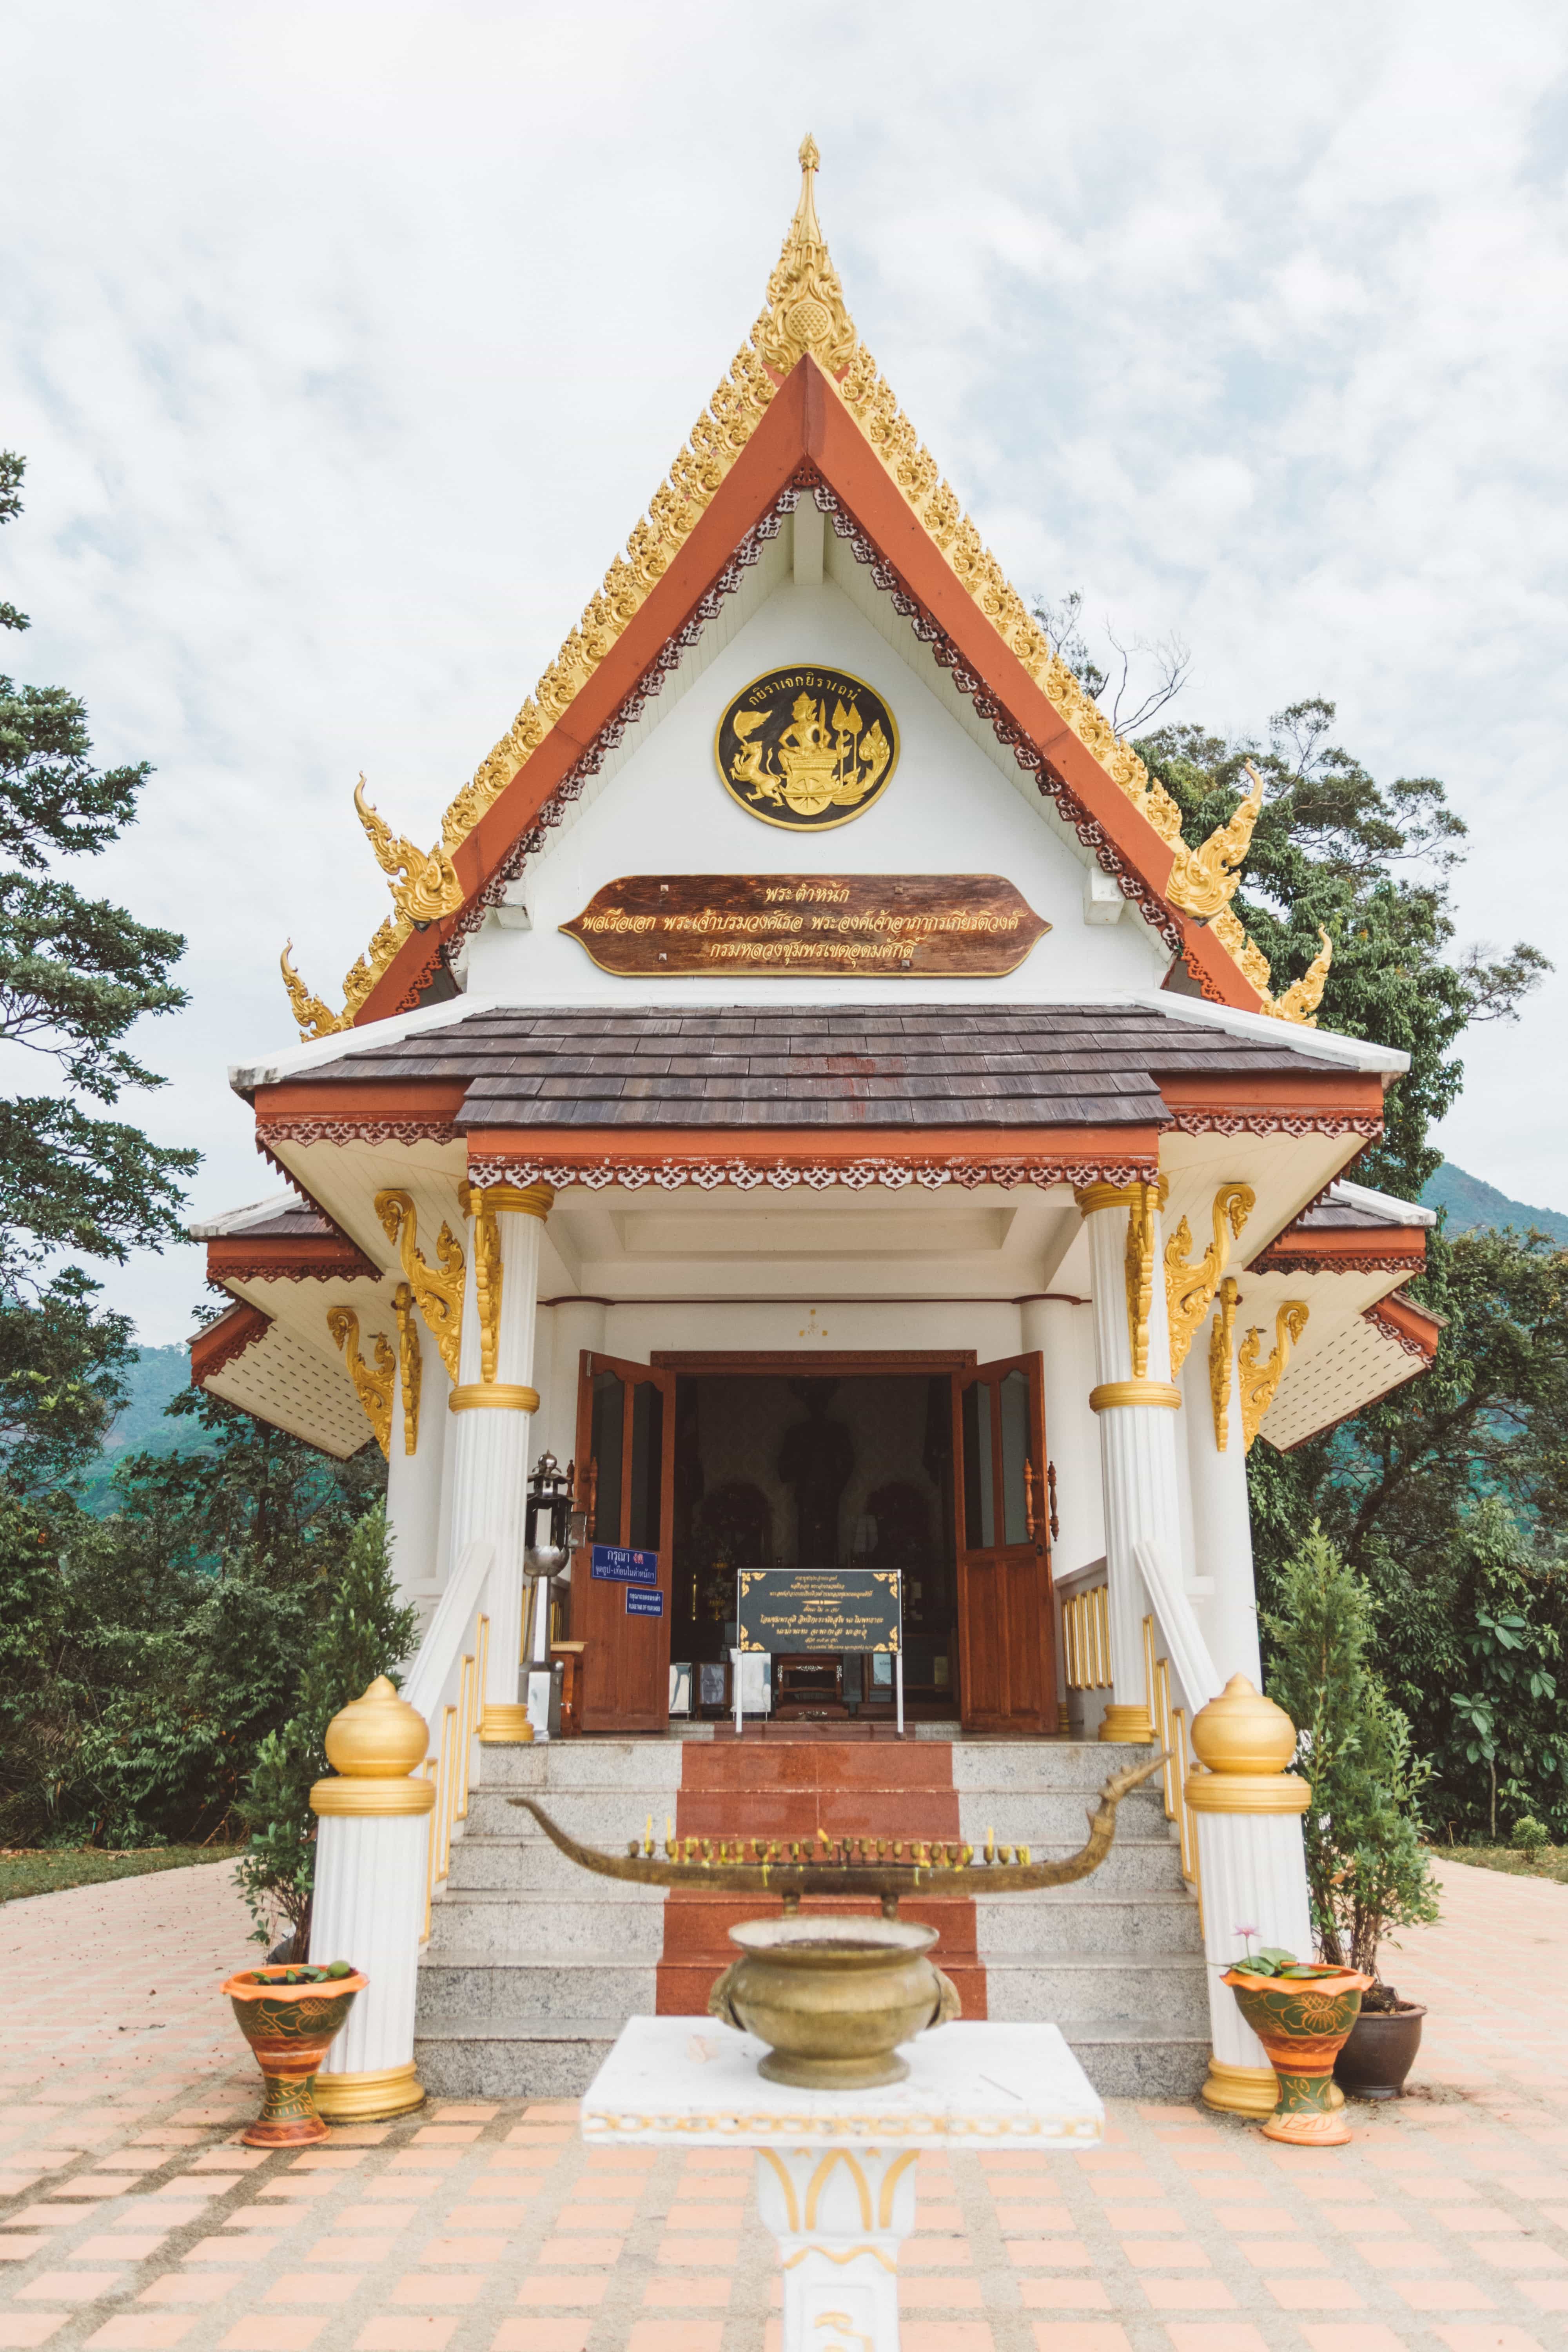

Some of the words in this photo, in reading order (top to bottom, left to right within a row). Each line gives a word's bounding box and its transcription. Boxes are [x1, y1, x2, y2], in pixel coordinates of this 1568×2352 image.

[766, 883, 850, 902] พระตำหนัก
[582, 908, 656, 933] พลเรือเอก
[663, 909, 803, 933] พระเจ้าบรมวงศ์เธอ
[812, 908, 1028, 932] พระองค์เจ้าอาภากรเกียรติวงศ์
[710, 935, 926, 968] กรมหลวงชุมพรเขตอุดมศักดิ์
[608, 1550, 630, 1565] กรุณา
[633, 1553, 644, 1564] งด
